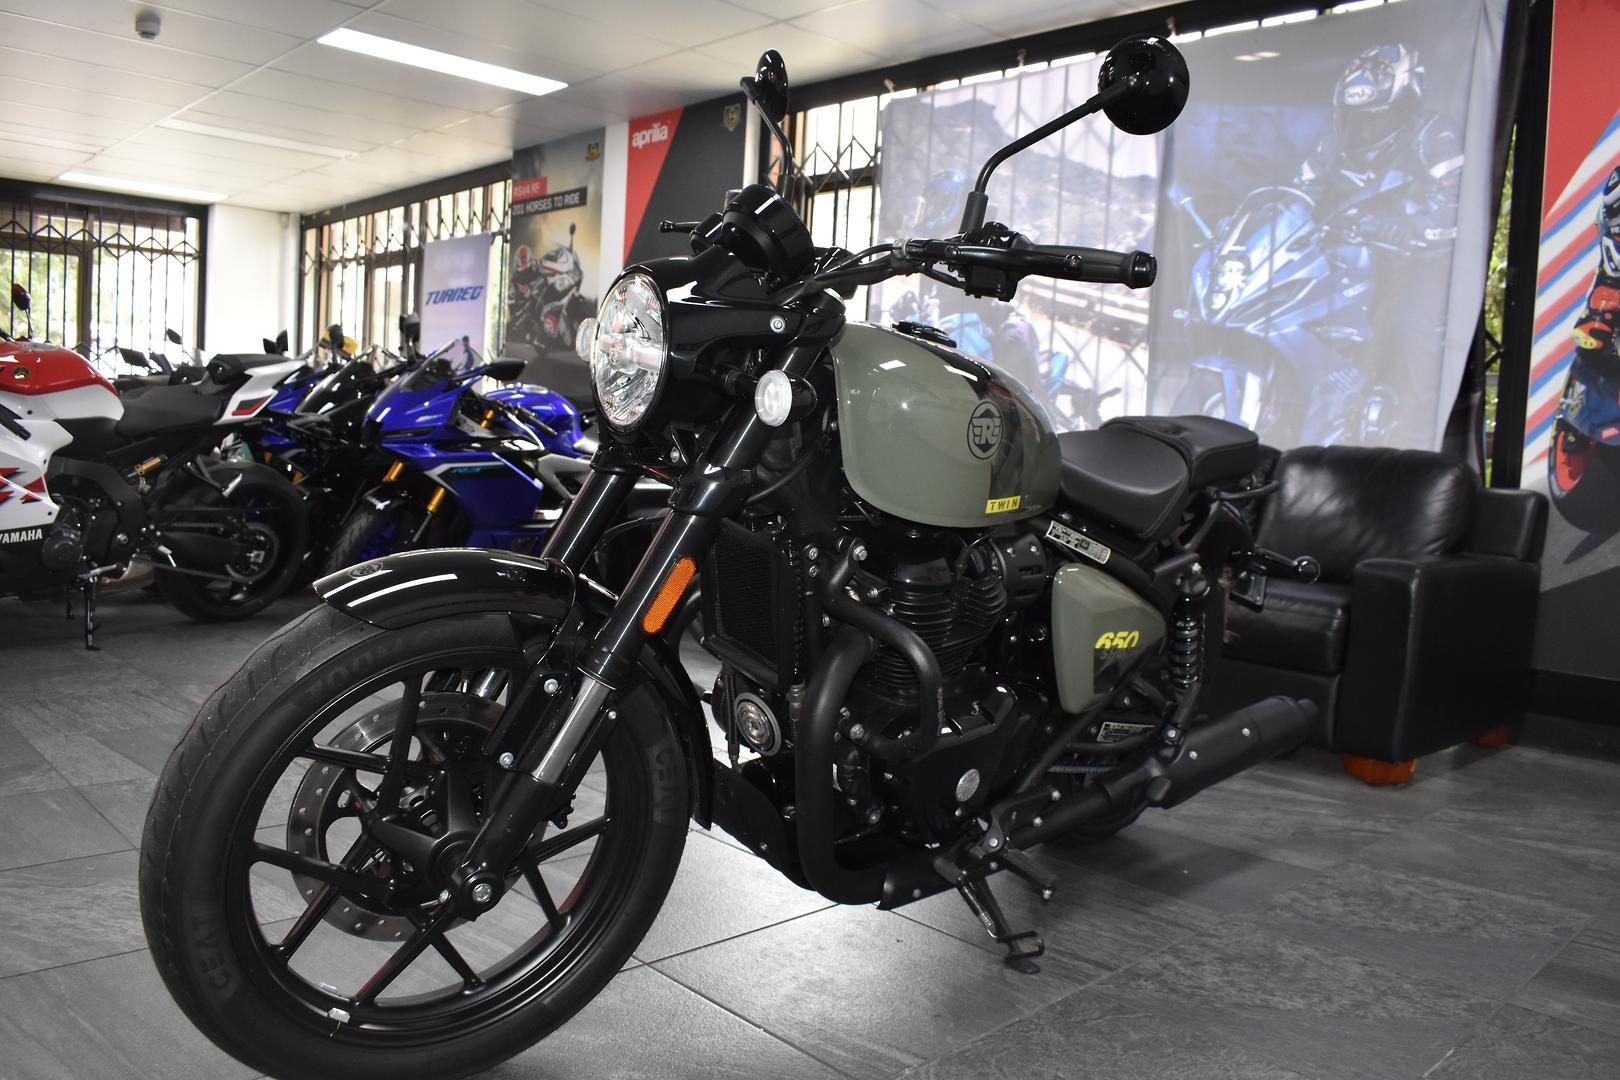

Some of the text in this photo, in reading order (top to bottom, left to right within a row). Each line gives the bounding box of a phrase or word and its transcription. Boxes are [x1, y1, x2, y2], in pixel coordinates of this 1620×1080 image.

[632, 122, 669, 149] aprilia
[526, 197, 552, 213] HORSES
[553, 195, 563, 208] TO
[564, 192, 580, 206] RIDE
[989, 498, 1019, 512] TWIN
[1095, 630, 1140, 649] 650
